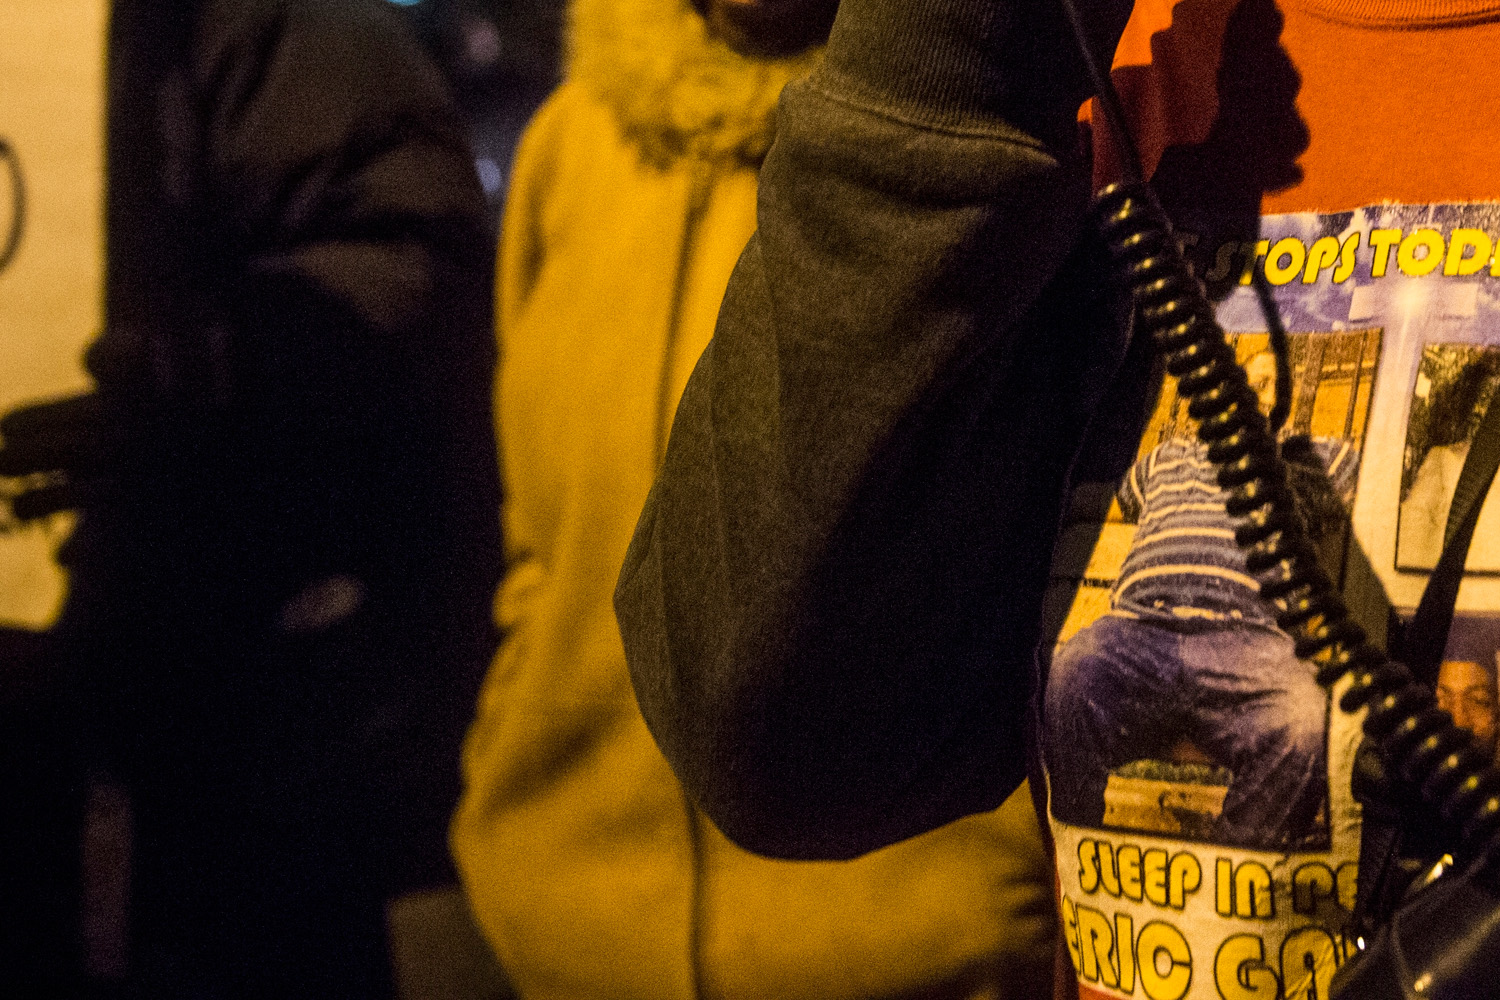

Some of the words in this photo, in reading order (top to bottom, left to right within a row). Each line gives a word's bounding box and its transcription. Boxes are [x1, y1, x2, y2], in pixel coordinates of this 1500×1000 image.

[1205, 229, 1361, 286] STOPS
[1077, 838, 1202, 910] SLEEP
[1214, 857, 1276, 921] IN
